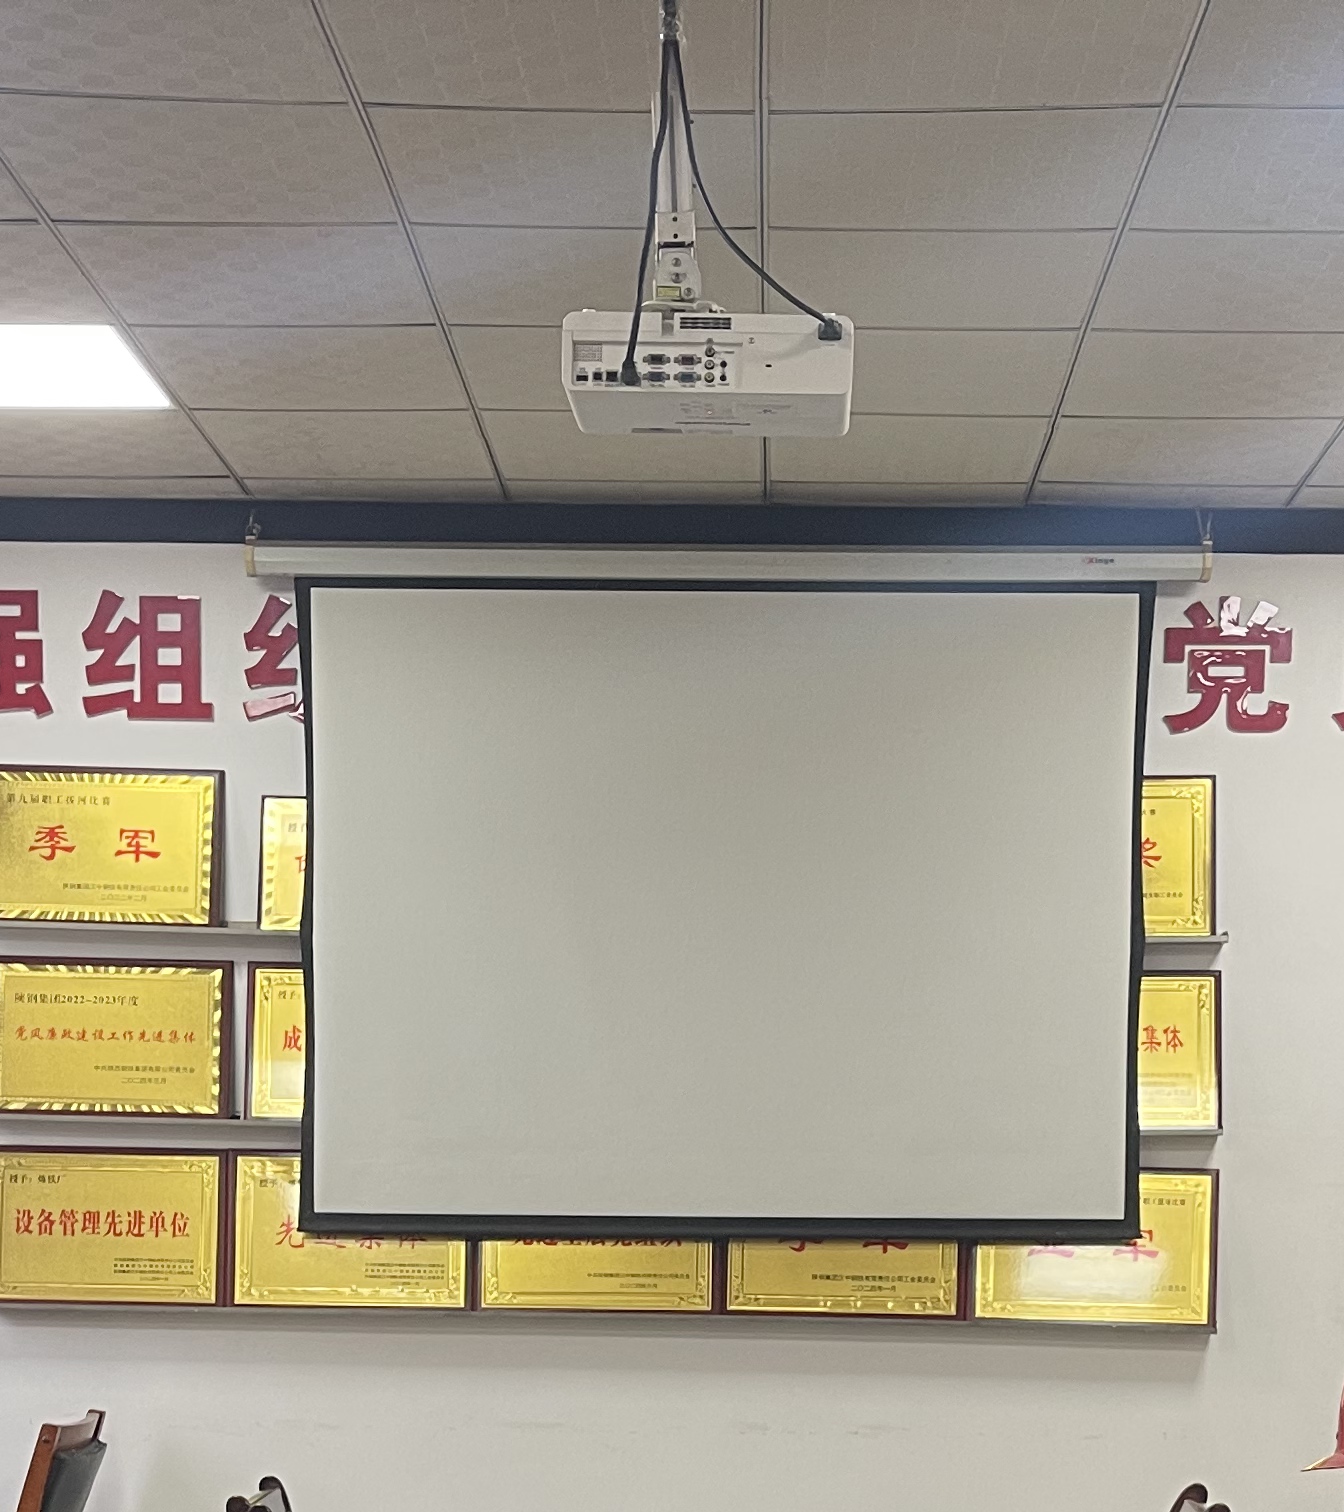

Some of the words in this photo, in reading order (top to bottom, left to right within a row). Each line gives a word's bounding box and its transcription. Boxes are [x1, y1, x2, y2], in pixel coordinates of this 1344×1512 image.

[28, 824, 161, 863] 季军
[15, 1026, 196, 1044] 党风廉政建设工作先进集体
[1140, 1026, 1184, 1054] 集体
[14, 1208, 190, 1238] 设备管理先进单位
